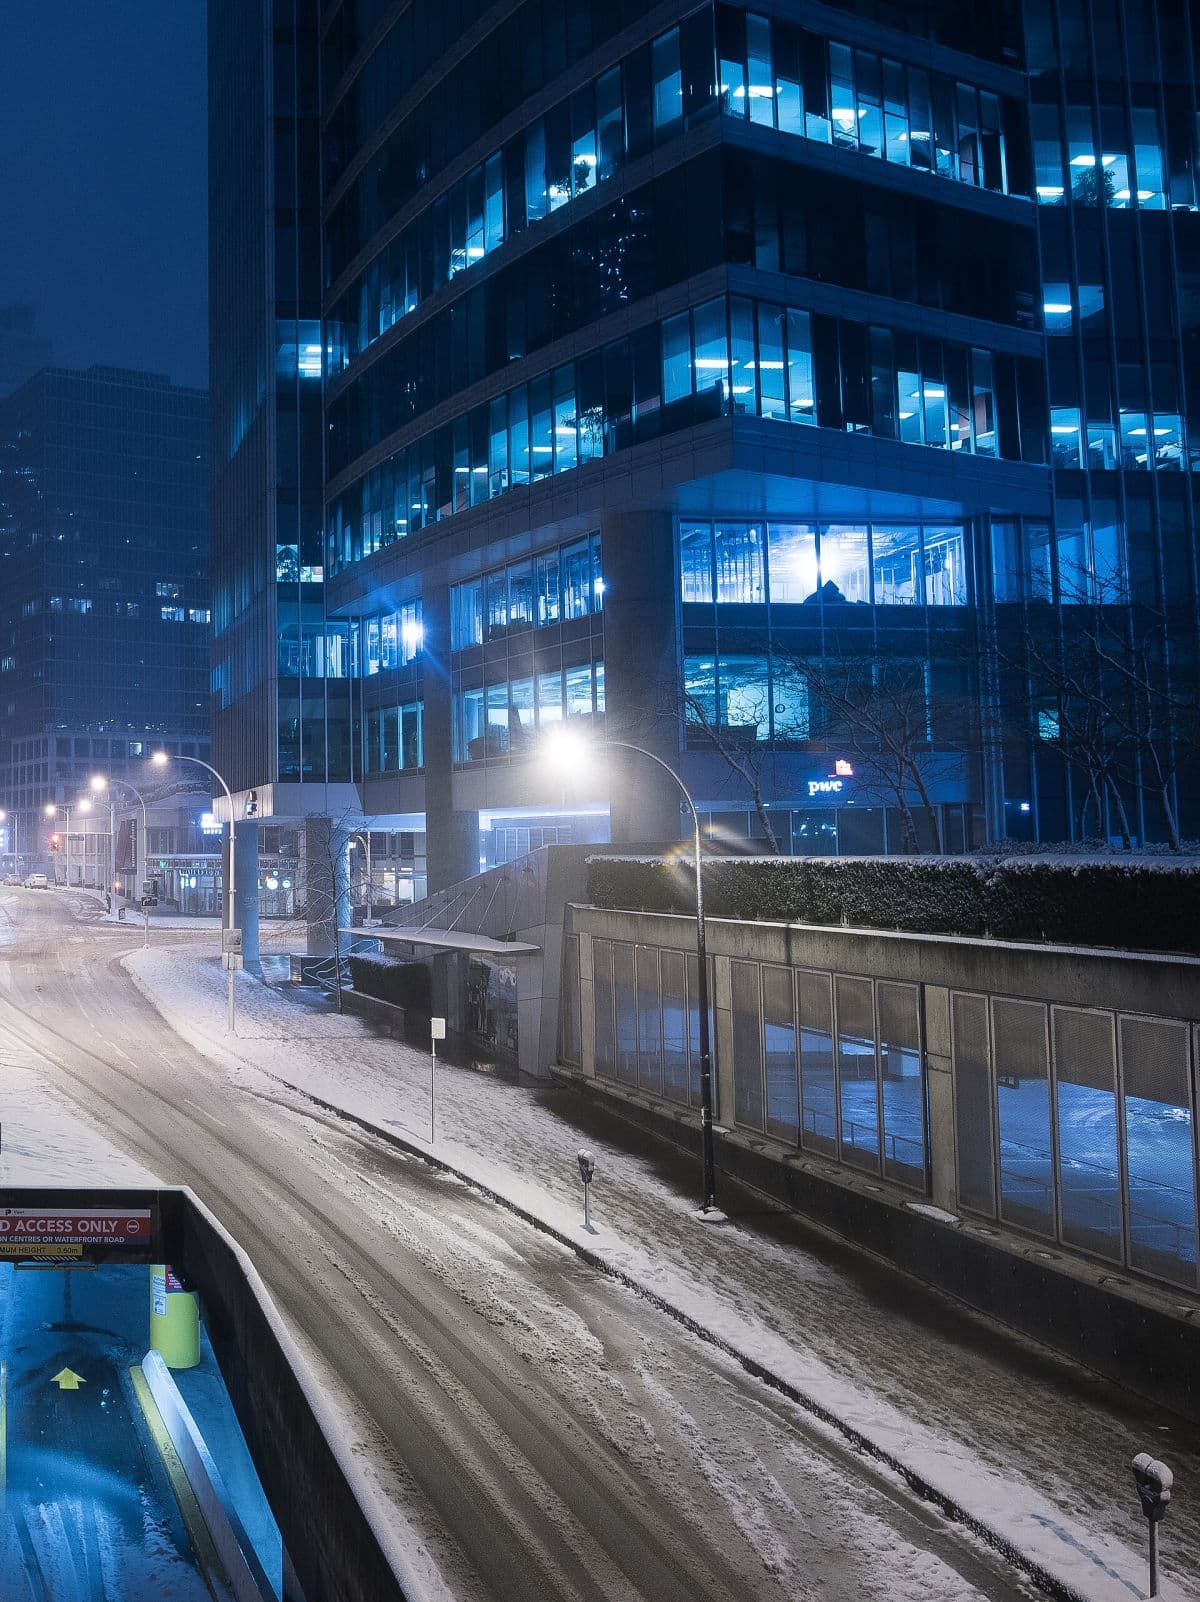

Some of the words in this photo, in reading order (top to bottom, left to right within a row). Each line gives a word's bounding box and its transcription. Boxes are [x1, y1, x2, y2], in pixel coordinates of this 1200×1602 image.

[808, 780, 843, 796] pwc
[14, 1219, 73, 1232] ACCESS
[78, 1219, 118, 1233] ONLY
[54, 1236, 102, 1244] WATERFRONT
[103, 1236, 125, 1244] ROAD
[18, 1246, 46, 1254] HEIGHT
